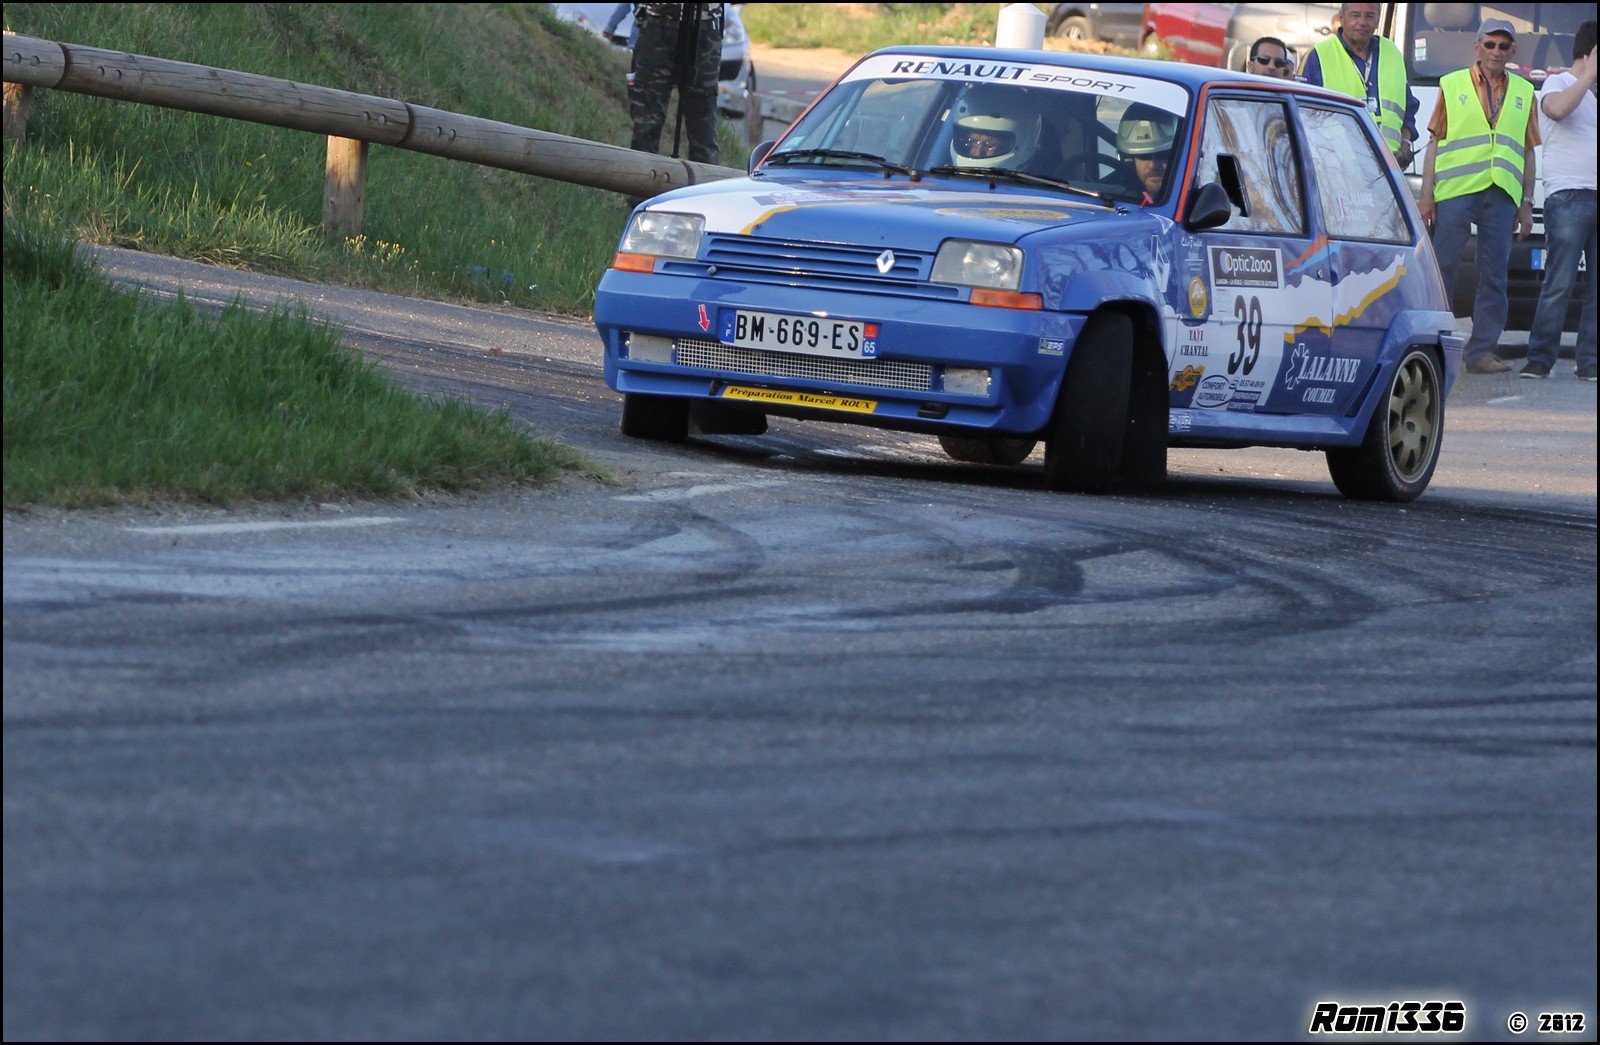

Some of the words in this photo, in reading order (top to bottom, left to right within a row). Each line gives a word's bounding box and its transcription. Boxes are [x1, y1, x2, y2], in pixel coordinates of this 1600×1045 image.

[890, 60, 1031, 80] RENAULT
[1030, 73, 1137, 92] SPORT
[735, 314, 860, 351] BM-669-ES
[1227, 294, 1263, 375] 39
[863, 341, 875, 354] 65
[1180, 345, 1208, 356] CHANTAL
[1298, 355, 1361, 383] LALANNE
[1202, 380, 1226, 390] CONFORT
[797, 394, 835, 405] Marcel
[840, 399, 872, 409] ROUX
[1198, 391, 1228, 401] AUTOMOBILE
[1302, 387, 1336, 403] COUMEL
